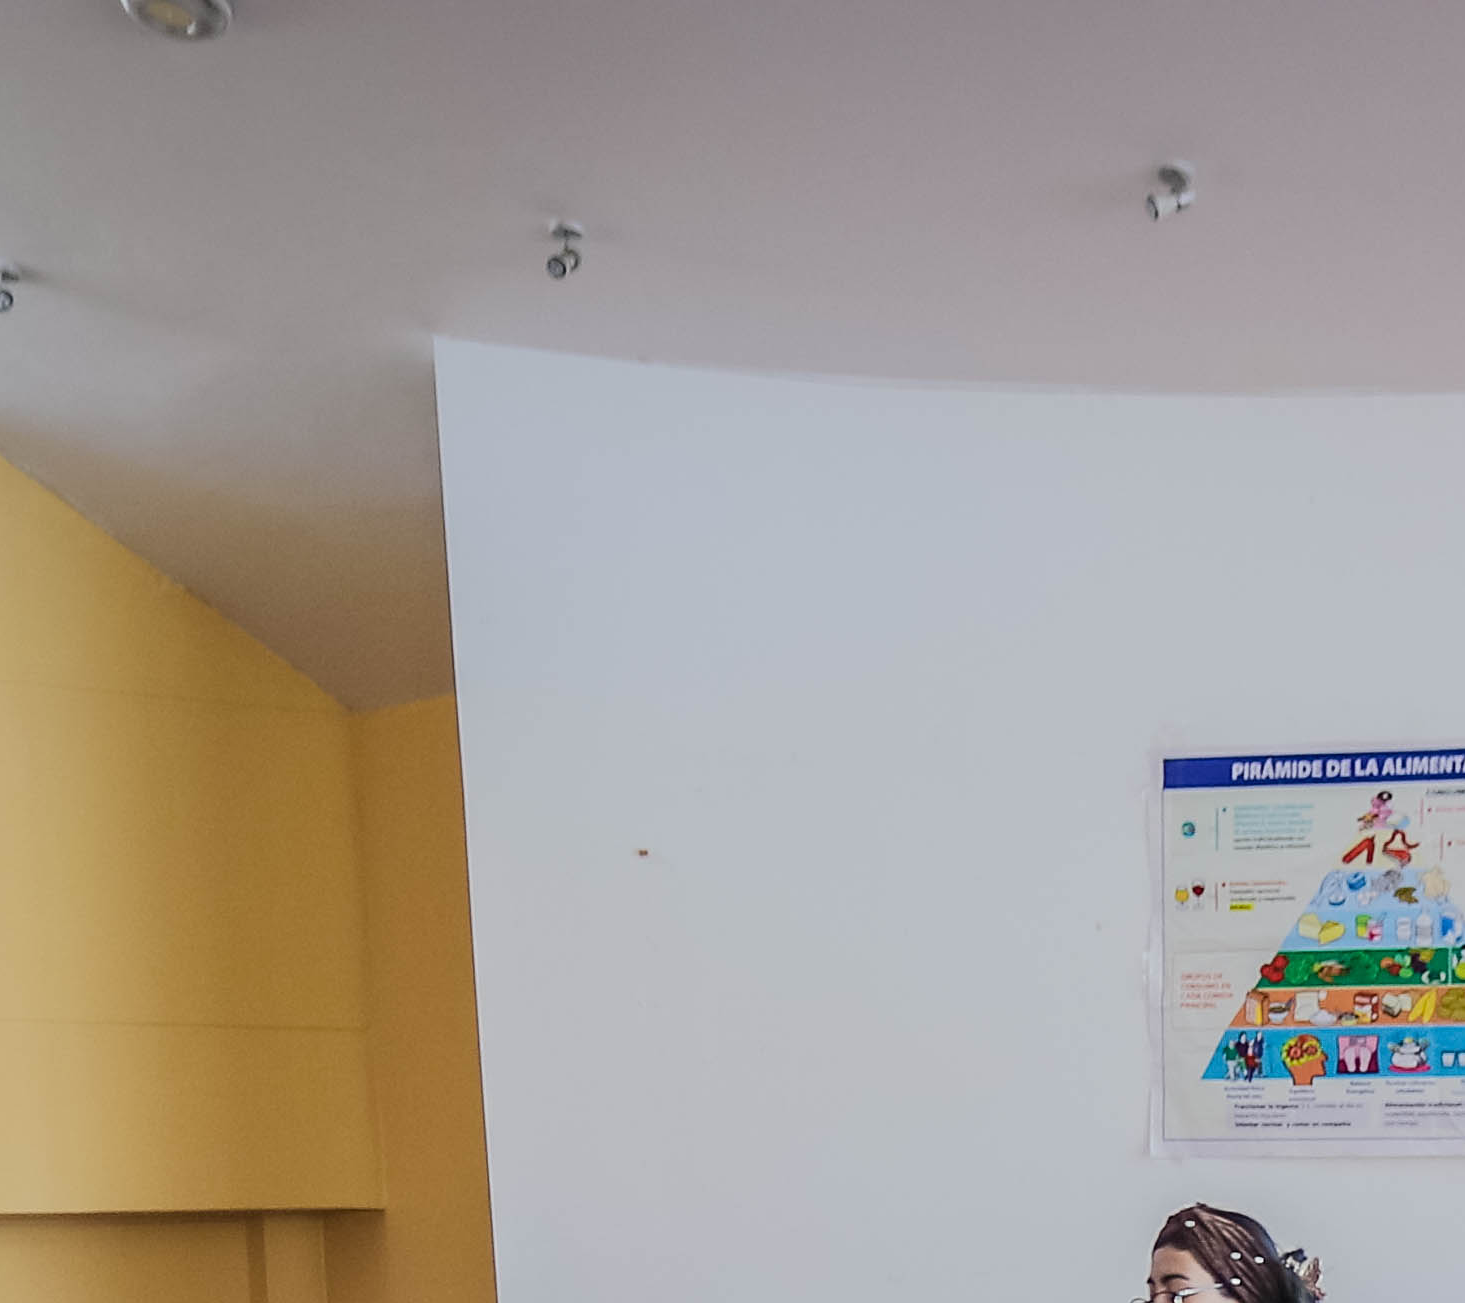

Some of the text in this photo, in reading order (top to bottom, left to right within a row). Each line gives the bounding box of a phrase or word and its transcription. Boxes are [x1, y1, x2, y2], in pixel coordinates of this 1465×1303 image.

[1231, 757, 1327, 782] PIRÁMIDE
[1328, 759, 1353, 779] DE
[1355, 757, 1378, 776] LA
